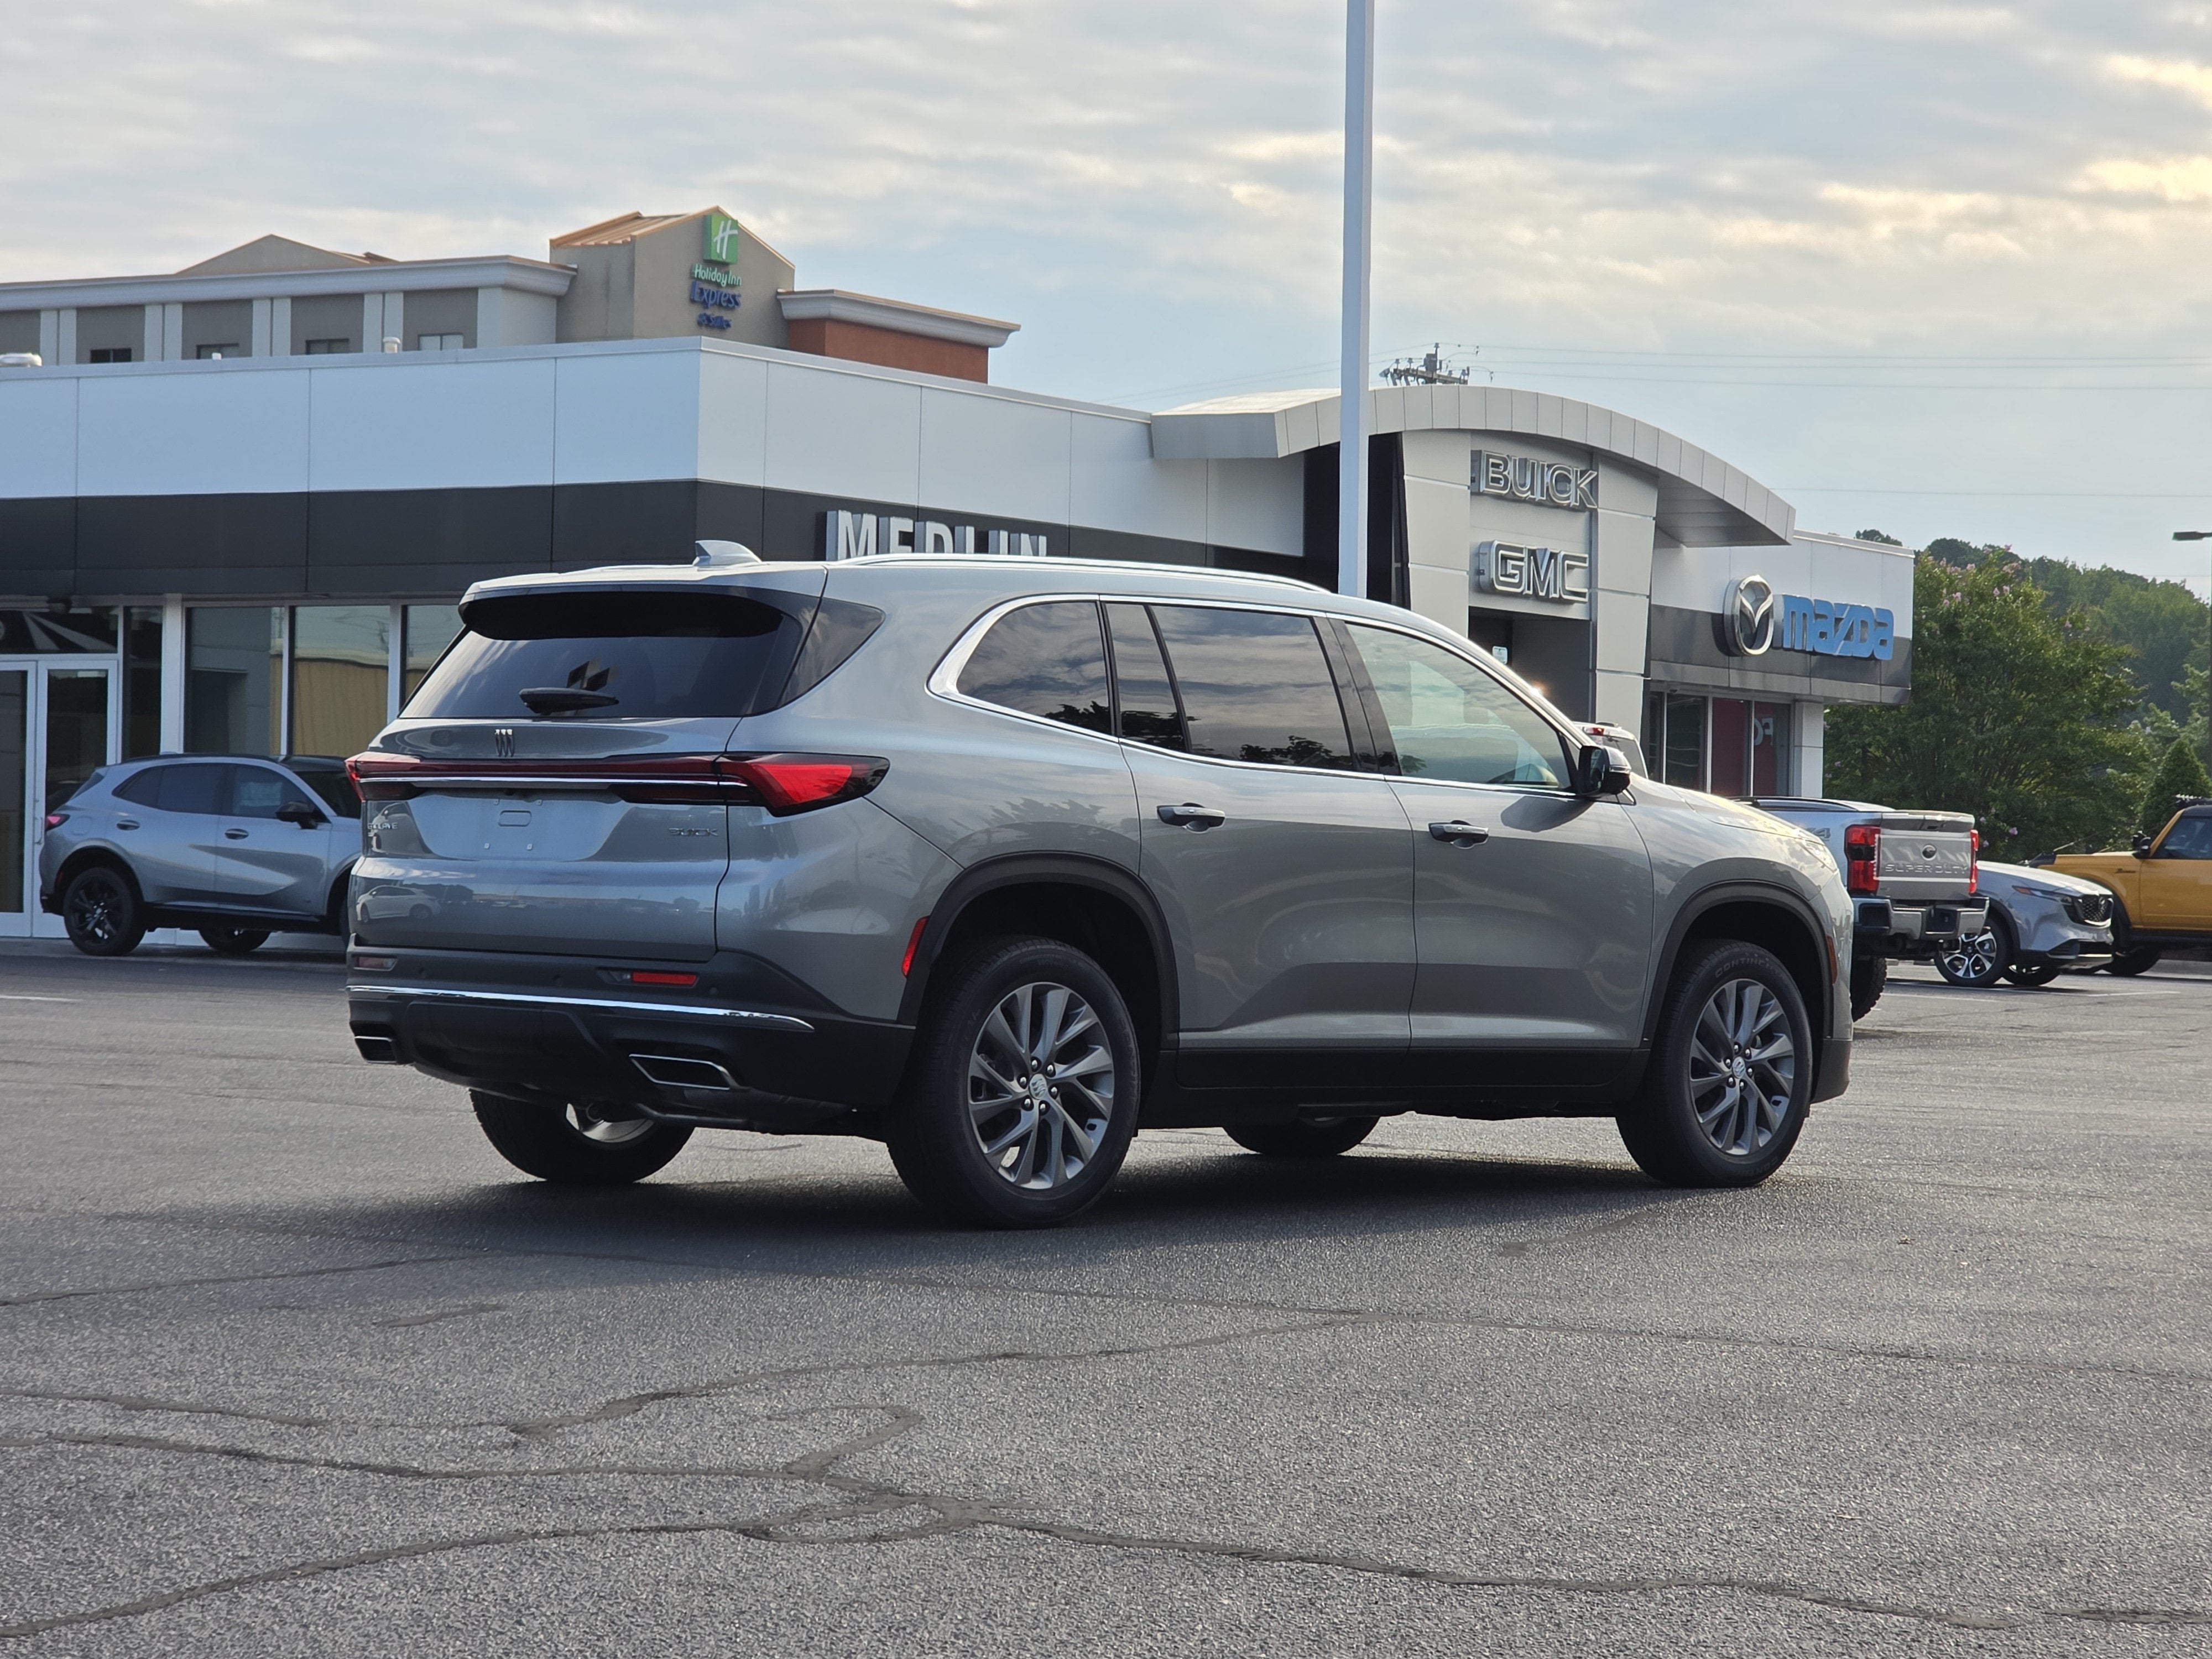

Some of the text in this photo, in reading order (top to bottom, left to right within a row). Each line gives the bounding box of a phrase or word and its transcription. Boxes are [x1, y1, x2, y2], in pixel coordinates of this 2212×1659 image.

[694, 264, 742, 287] Holiday Inn
[692, 281, 742, 309] Express
[1480, 450, 1598, 509] BUICK
[1491, 540, 1589, 602] GMC
[669, 828, 718, 836] BUICK
